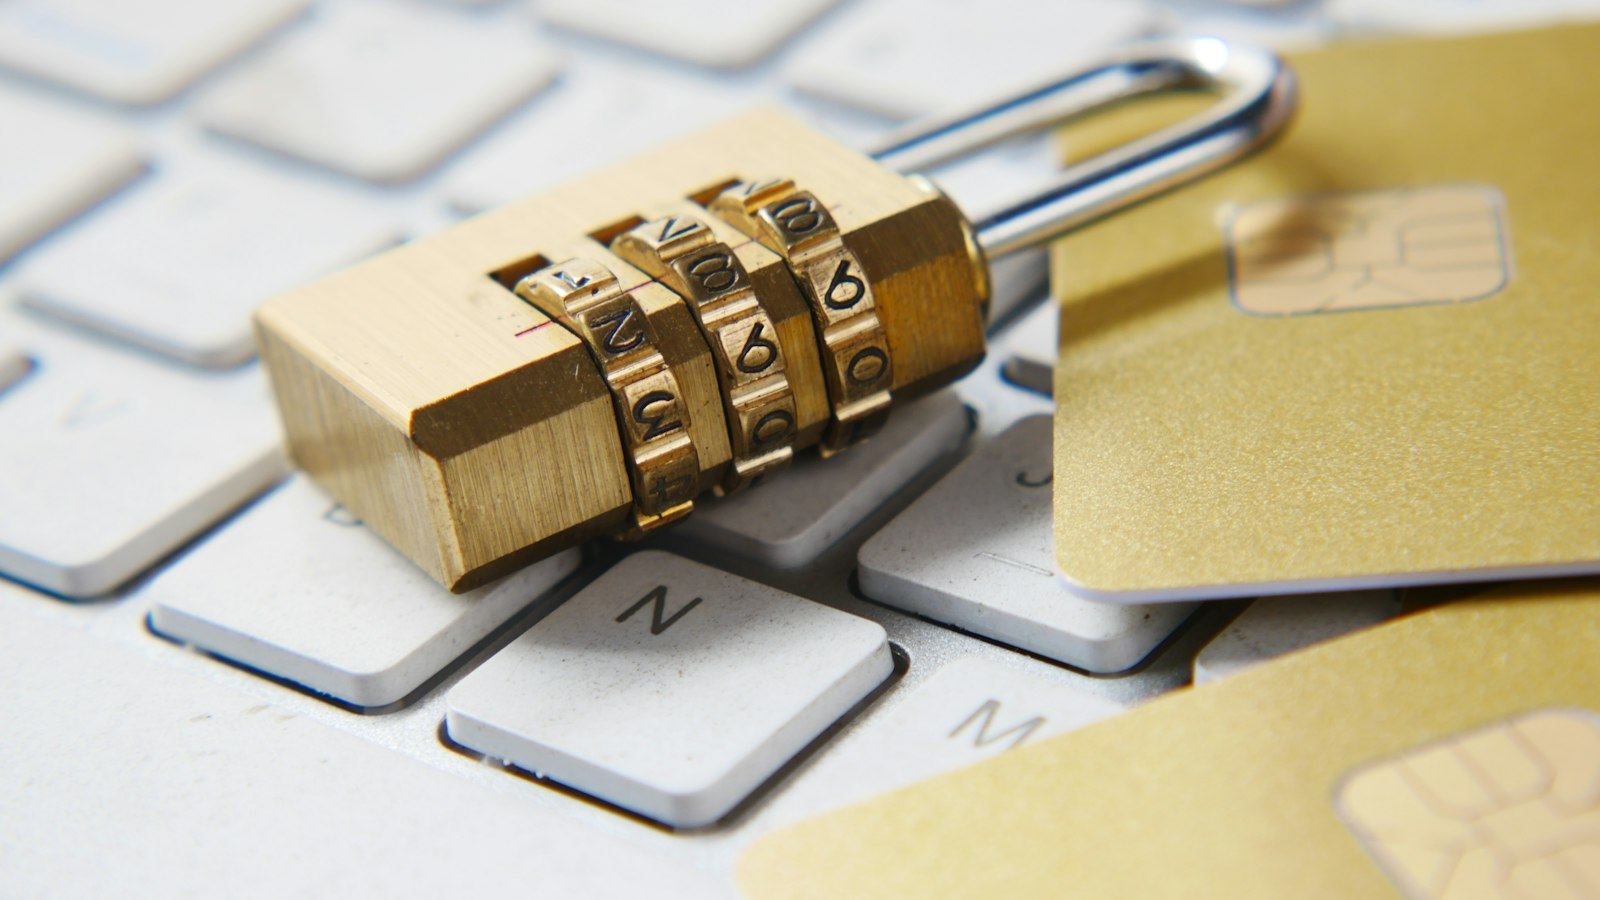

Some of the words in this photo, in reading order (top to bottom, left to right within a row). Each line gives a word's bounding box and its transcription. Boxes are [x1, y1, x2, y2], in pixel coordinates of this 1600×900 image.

[769, 199, 823, 233] 8
[688, 253, 739, 293] 8
[589, 308, 647, 354] 2
[632, 390, 684, 442] 3
[615, 585, 703, 636] N
[946, 699, 1048, 749] M
